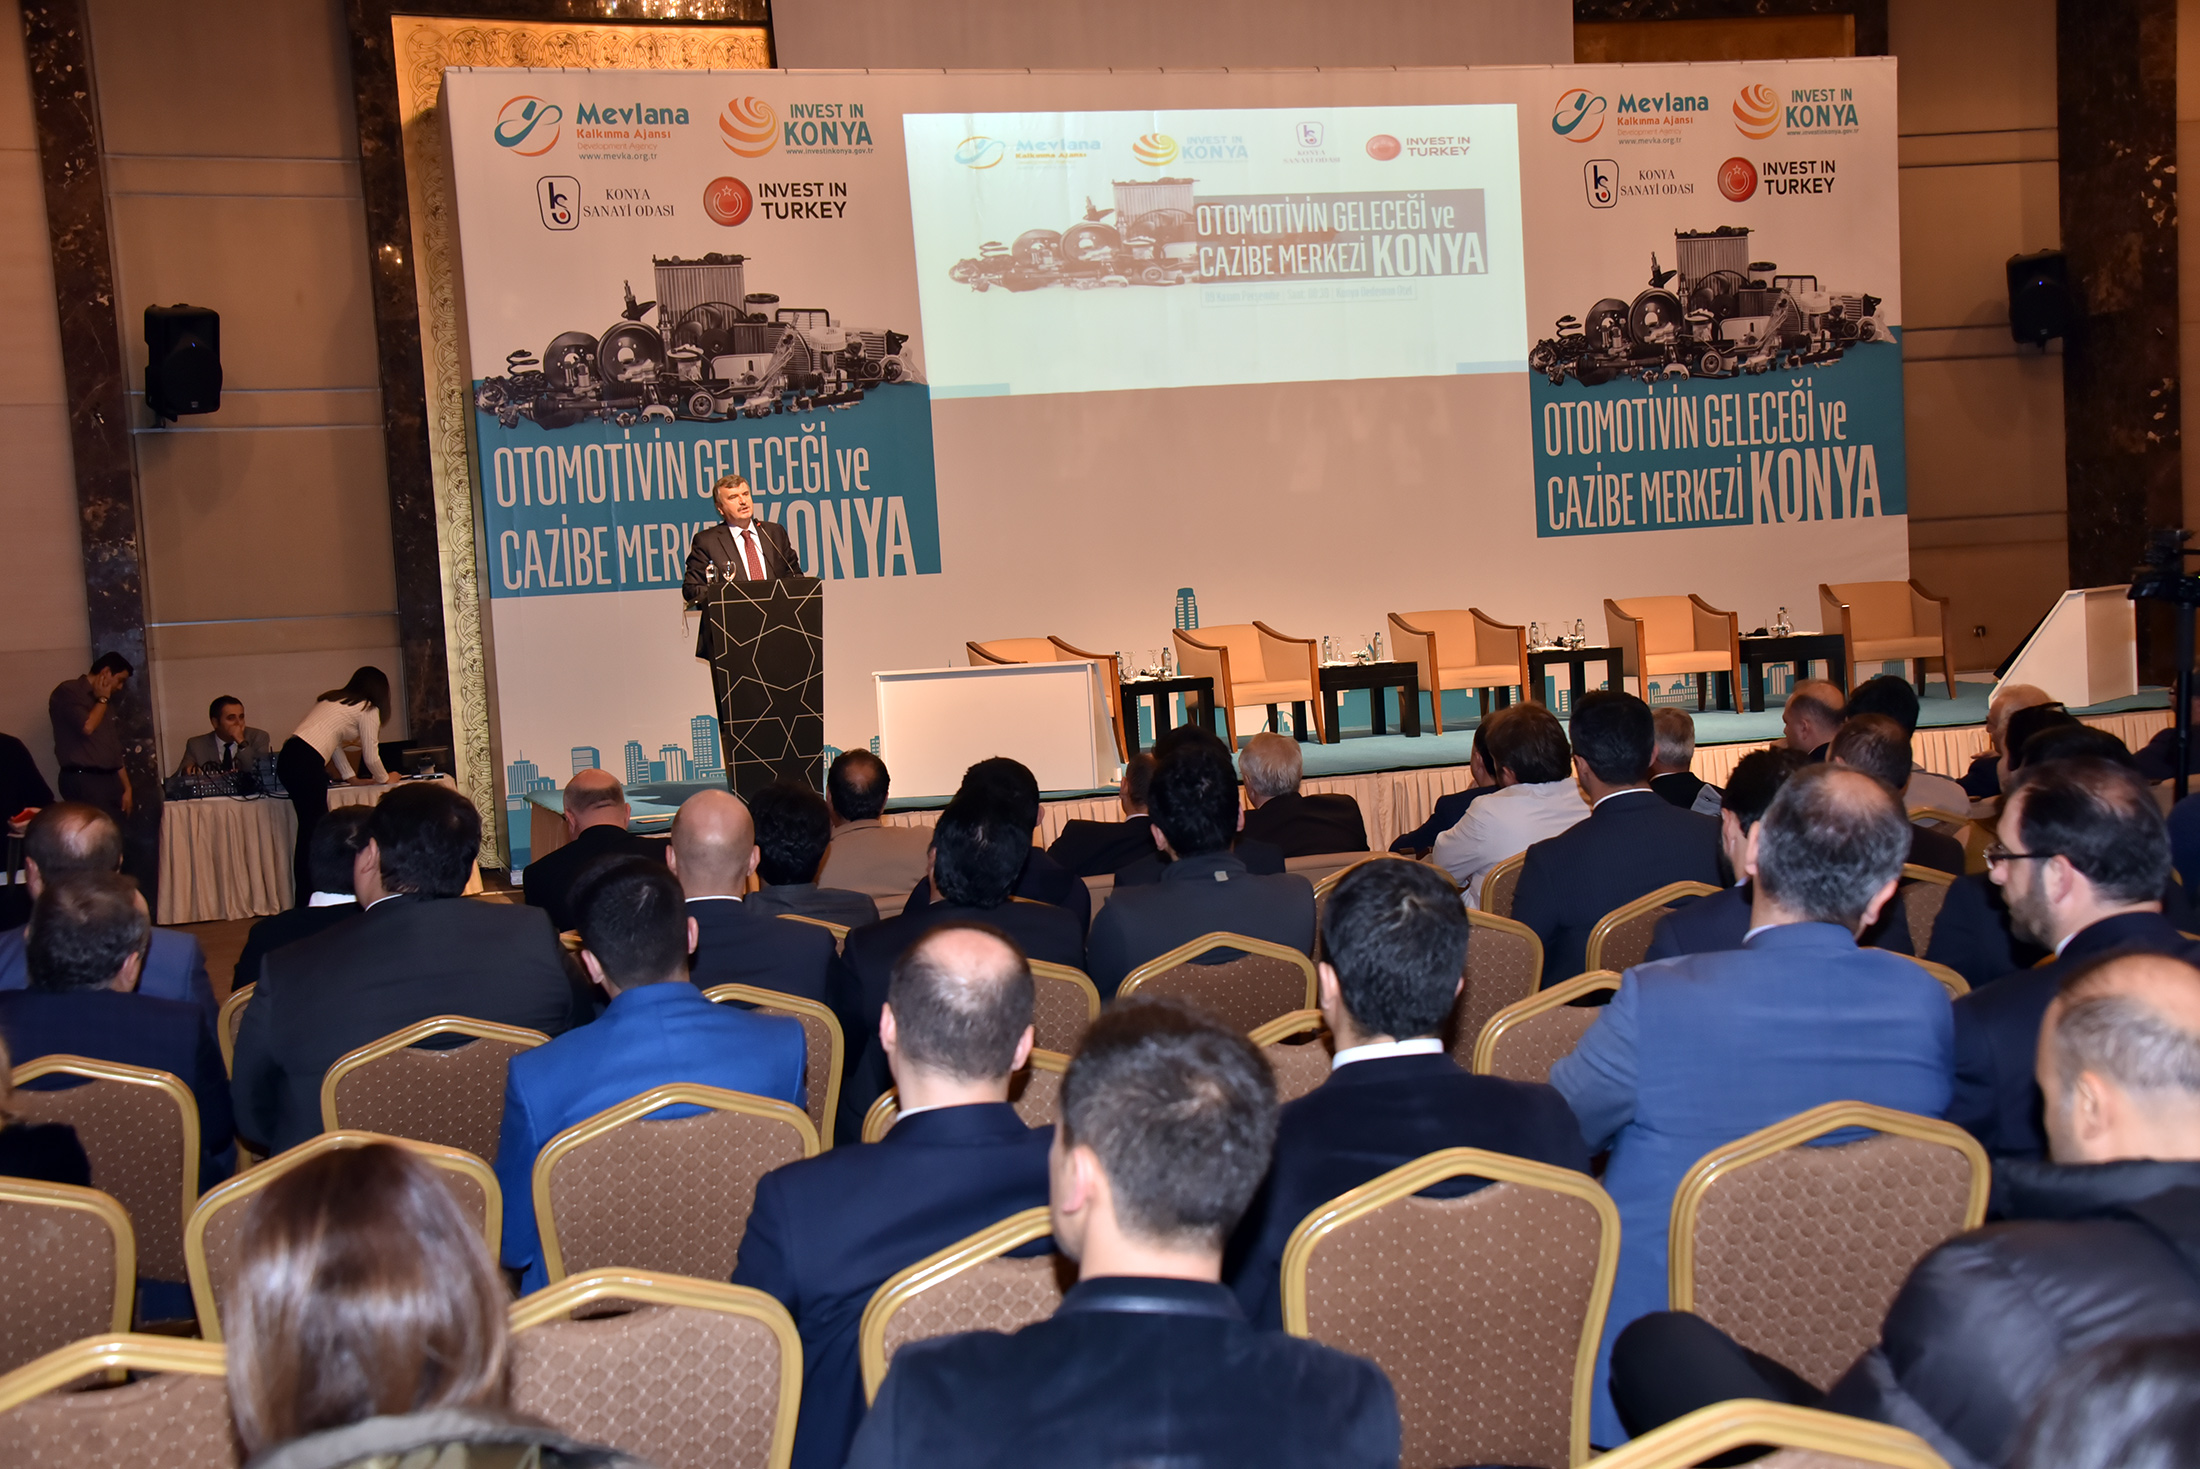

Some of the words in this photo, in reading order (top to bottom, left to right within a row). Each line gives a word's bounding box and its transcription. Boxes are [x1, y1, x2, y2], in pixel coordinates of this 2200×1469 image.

[1617, 92, 1709, 113] Mevlana
[1792, 88, 1836, 102] INVEST
[1841, 88, 1852, 101] IN
[576, 102, 689, 125] Mevlana
[790, 104, 844, 119] INVEST
[849, 104, 864, 118] IN
[1786, 104, 1858, 128] KONYA
[1617, 117, 1660, 126] Kalkınma
[1663, 116, 1693, 126] Ajansı
[576, 129, 630, 139] Kalkınma
[634, 129, 671, 140] Ajansı
[784, 121, 873, 146] KONYA
[1186, 136, 1227, 144] INVEST
[1232, 136, 1243, 144] IN
[1406, 137, 1454, 146] INVEST
[1458, 136, 1471, 145] IN
[1618, 137, 1682, 145] www.mevka.org.tr
[577, 142, 627, 151] Development
[629, 142, 658, 151] Agency
[786, 147, 874, 156] www.investinkonya.gov.tr
[1016, 138, 1101, 151] Mevlana
[1408, 146, 1471, 157] TURKEY
[578, 152, 658, 162] www.mevka.org.tr
[1182, 145, 1249, 160] KONYA
[1639, 169, 1675, 181] KONYA
[1762, 161, 1817, 176] INVEST
[1820, 160, 1836, 174] IN
[759, 182, 825, 198] INVEST
[829, 182, 848, 198] IN
[1620, 183, 1660, 196] SANAYİ
[1662, 183, 1695, 195] ODASI
[1764, 177, 1836, 196] TURKEY
[605, 188, 651, 201] KONYA
[583, 204, 633, 218] SANAYİ
[635, 204, 675, 217] ODASI
[760, 201, 847, 220] TURKEY
[1196, 196, 1328, 236] OTOMOTİVİN
[1333, 193, 1427, 232] GELECEĞİ
[1431, 205, 1455, 229] ve
[1199, 239, 1273, 277] CAZİBE
[1278, 236, 1367, 275] MERKEZİ
[1372, 232, 1486, 277] KONYA
[1544, 384, 1699, 456] OTOMOTİVİN
[1704, 377, 1814, 448] GELECEĞİ
[1819, 400, 1848, 441] ve
[493, 427, 689, 508] OTOMOTİVİN
[835, 447, 871, 492] ve
[1547, 462, 1636, 531] CAZİBE
[1640, 454, 1744, 524] MERKEZİ
[1750, 444, 1883, 525] KONYA
[500, 514, 612, 591] CAZİBE
